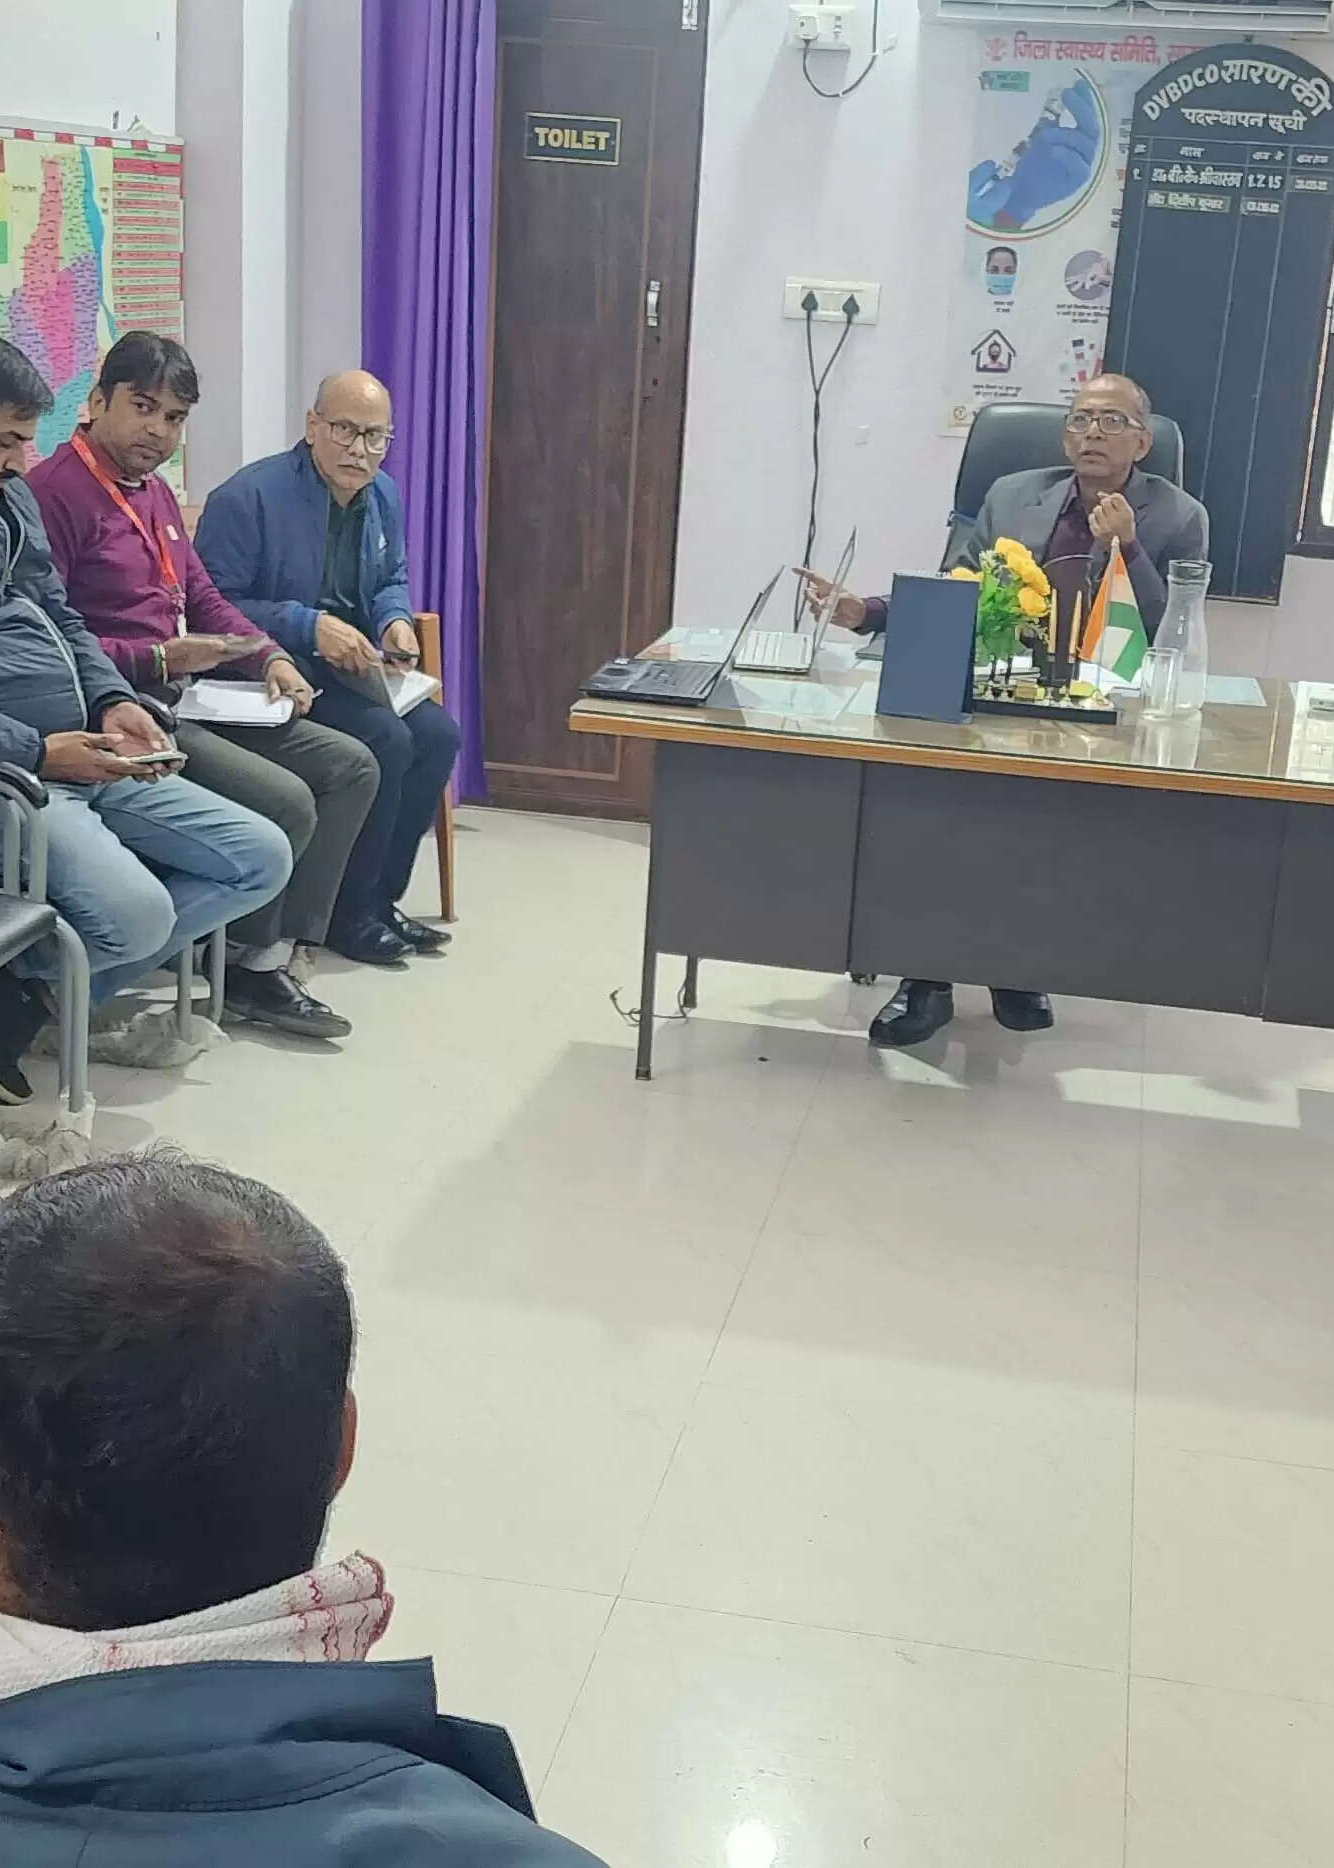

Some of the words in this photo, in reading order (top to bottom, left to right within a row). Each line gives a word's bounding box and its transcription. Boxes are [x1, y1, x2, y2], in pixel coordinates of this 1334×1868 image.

[1013, 30, 1052, 60] जिला
[1142, 64, 1219, 121] DVBDCO
[1220, 59, 1297, 91] सारण
[1291, 76, 1333, 117] की
[1180, 107, 1267, 129] पदस्थापन
[1268, 109, 1308, 134] सूची
[533, 126, 611, 151] TOILET
